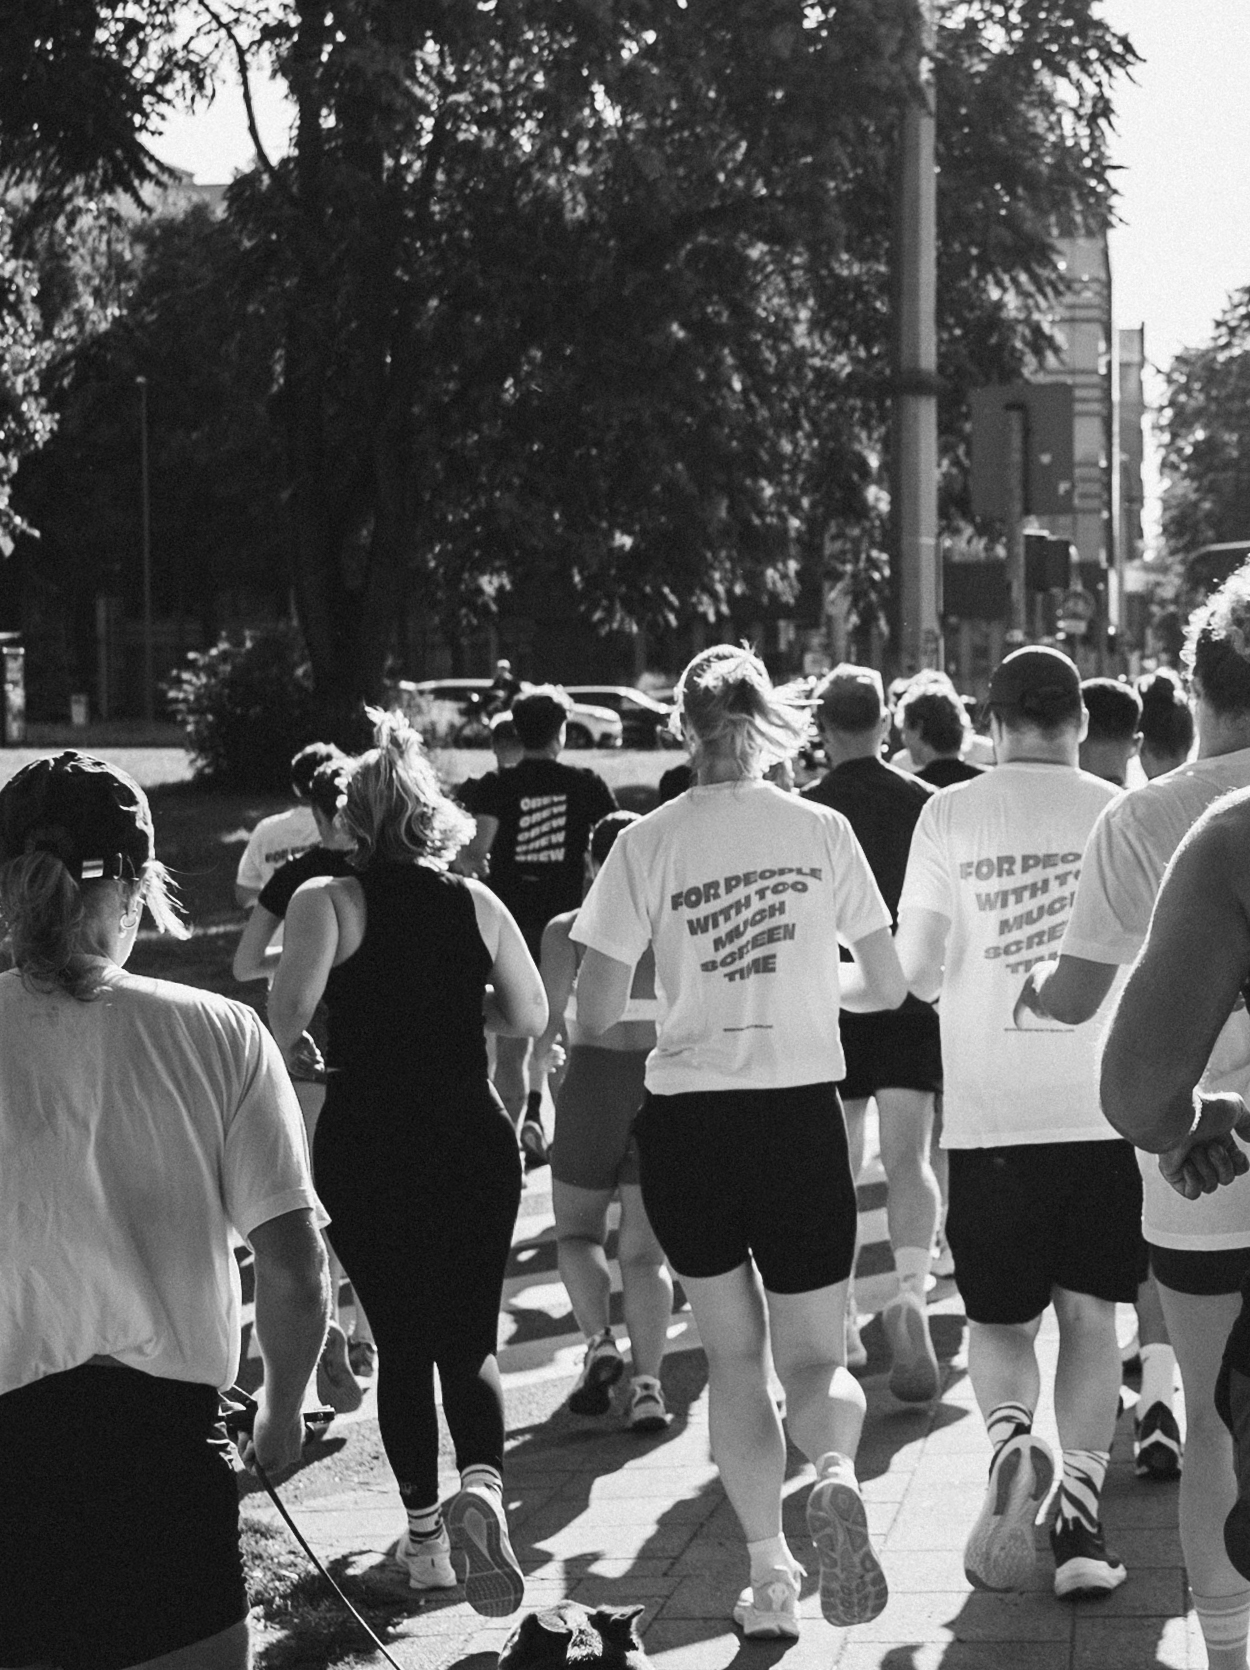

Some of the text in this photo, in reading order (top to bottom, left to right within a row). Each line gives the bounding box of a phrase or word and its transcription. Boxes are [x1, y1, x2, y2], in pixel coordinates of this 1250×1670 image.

[960, 852, 1082, 881] FOR PEO
[671, 867, 822, 911] FOR PEOPLE
[687, 881, 808, 936] WITH TOO
[975, 878, 1050, 911] WITH
[713, 900, 785, 952] MUCH
[984, 920, 1068, 959] SCRE
[700, 923, 796, 972] SCREEN
[1005, 951, 1059, 974] TI
[723, 953, 777, 982] TIME
